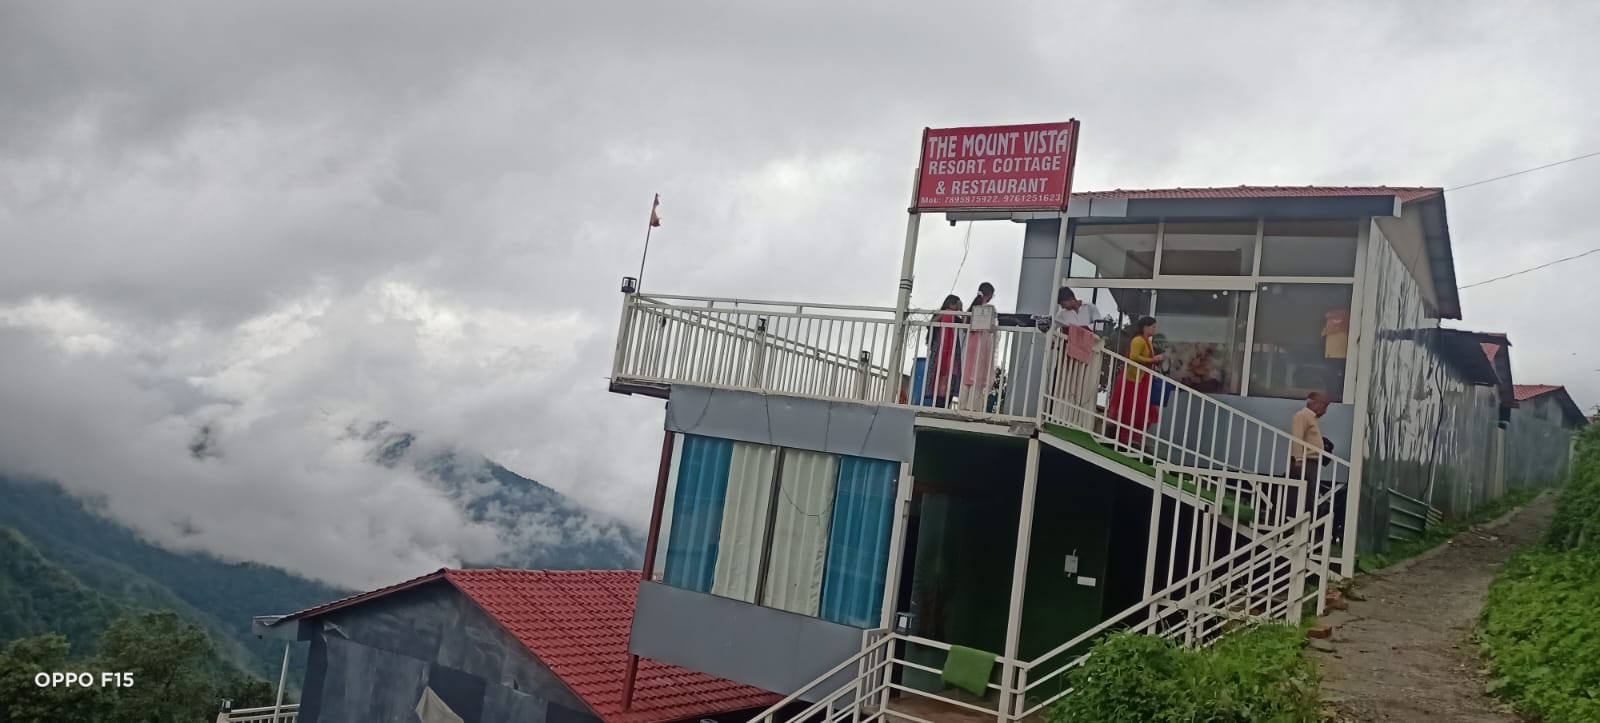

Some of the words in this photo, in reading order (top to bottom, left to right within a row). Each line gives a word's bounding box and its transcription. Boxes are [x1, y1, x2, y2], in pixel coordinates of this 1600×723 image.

[928, 135, 957, 160] THE
[962, 132, 1020, 157] MOUNT
[1024, 129, 1069, 154] VISTA
[928, 158, 987, 175] RESORT,
[993, 155, 1062, 173] COTTAGE
[935, 181, 946, 195] &
[951, 177, 1049, 195] RESTAURANT
[1003, 193, 1062, 203] 9761251623
